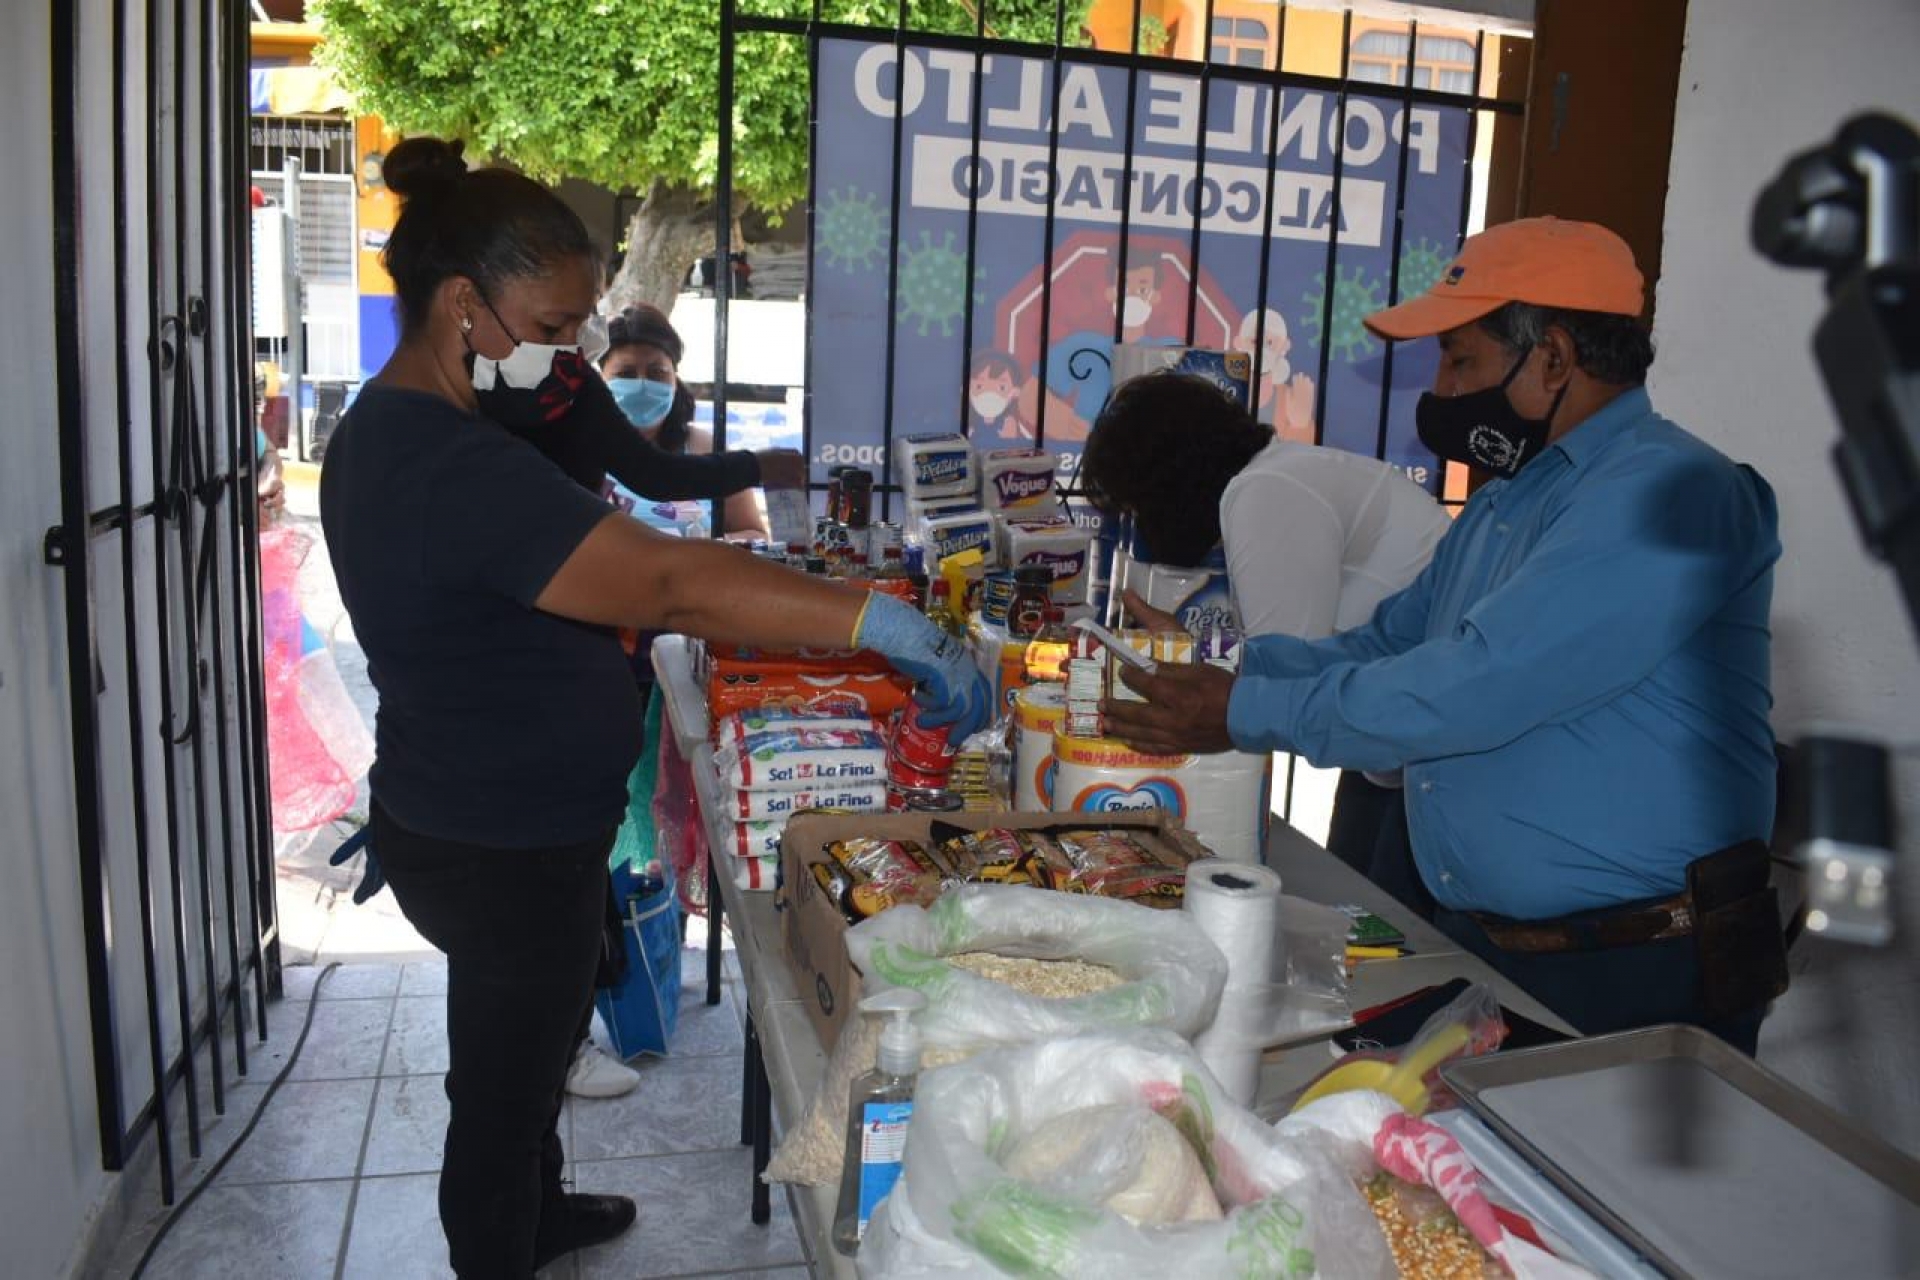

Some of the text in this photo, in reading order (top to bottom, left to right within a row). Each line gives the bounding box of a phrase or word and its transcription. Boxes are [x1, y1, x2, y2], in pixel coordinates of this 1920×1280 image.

[999, 473, 1048, 495] Vogue
[768, 762, 875, 781] Sal La Fina
[767, 793, 873, 813] Sal La Fina
